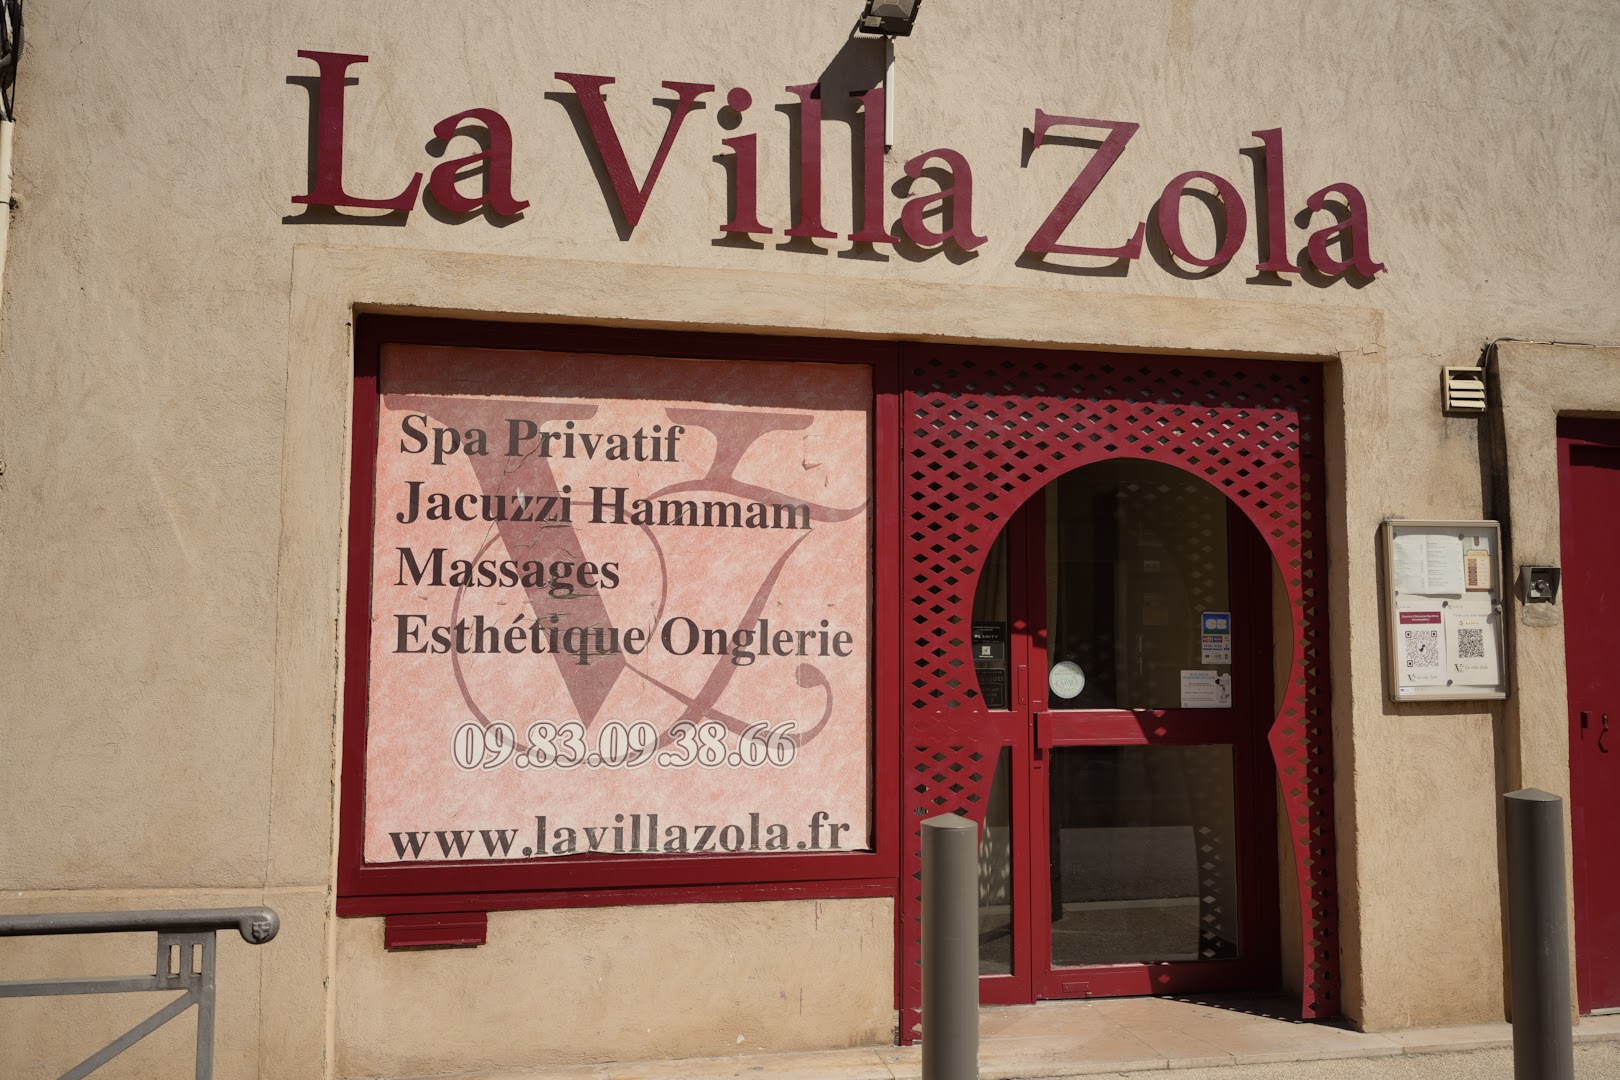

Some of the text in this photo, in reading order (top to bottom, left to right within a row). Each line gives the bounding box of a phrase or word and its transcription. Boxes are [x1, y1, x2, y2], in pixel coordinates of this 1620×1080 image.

[291, 49, 1385, 277] La Villa Zola
[400, 414, 686, 465] Spa Privatif
[396, 480, 813, 530] Jacuzzi Hammam
[394, 547, 620, 597] Massages
[392, 613, 854, 666] Esthétique Onglerie
[452, 720, 797, 771] 09.83.09.38.66
[389, 811, 850, 859] www.lavillazola.fr
